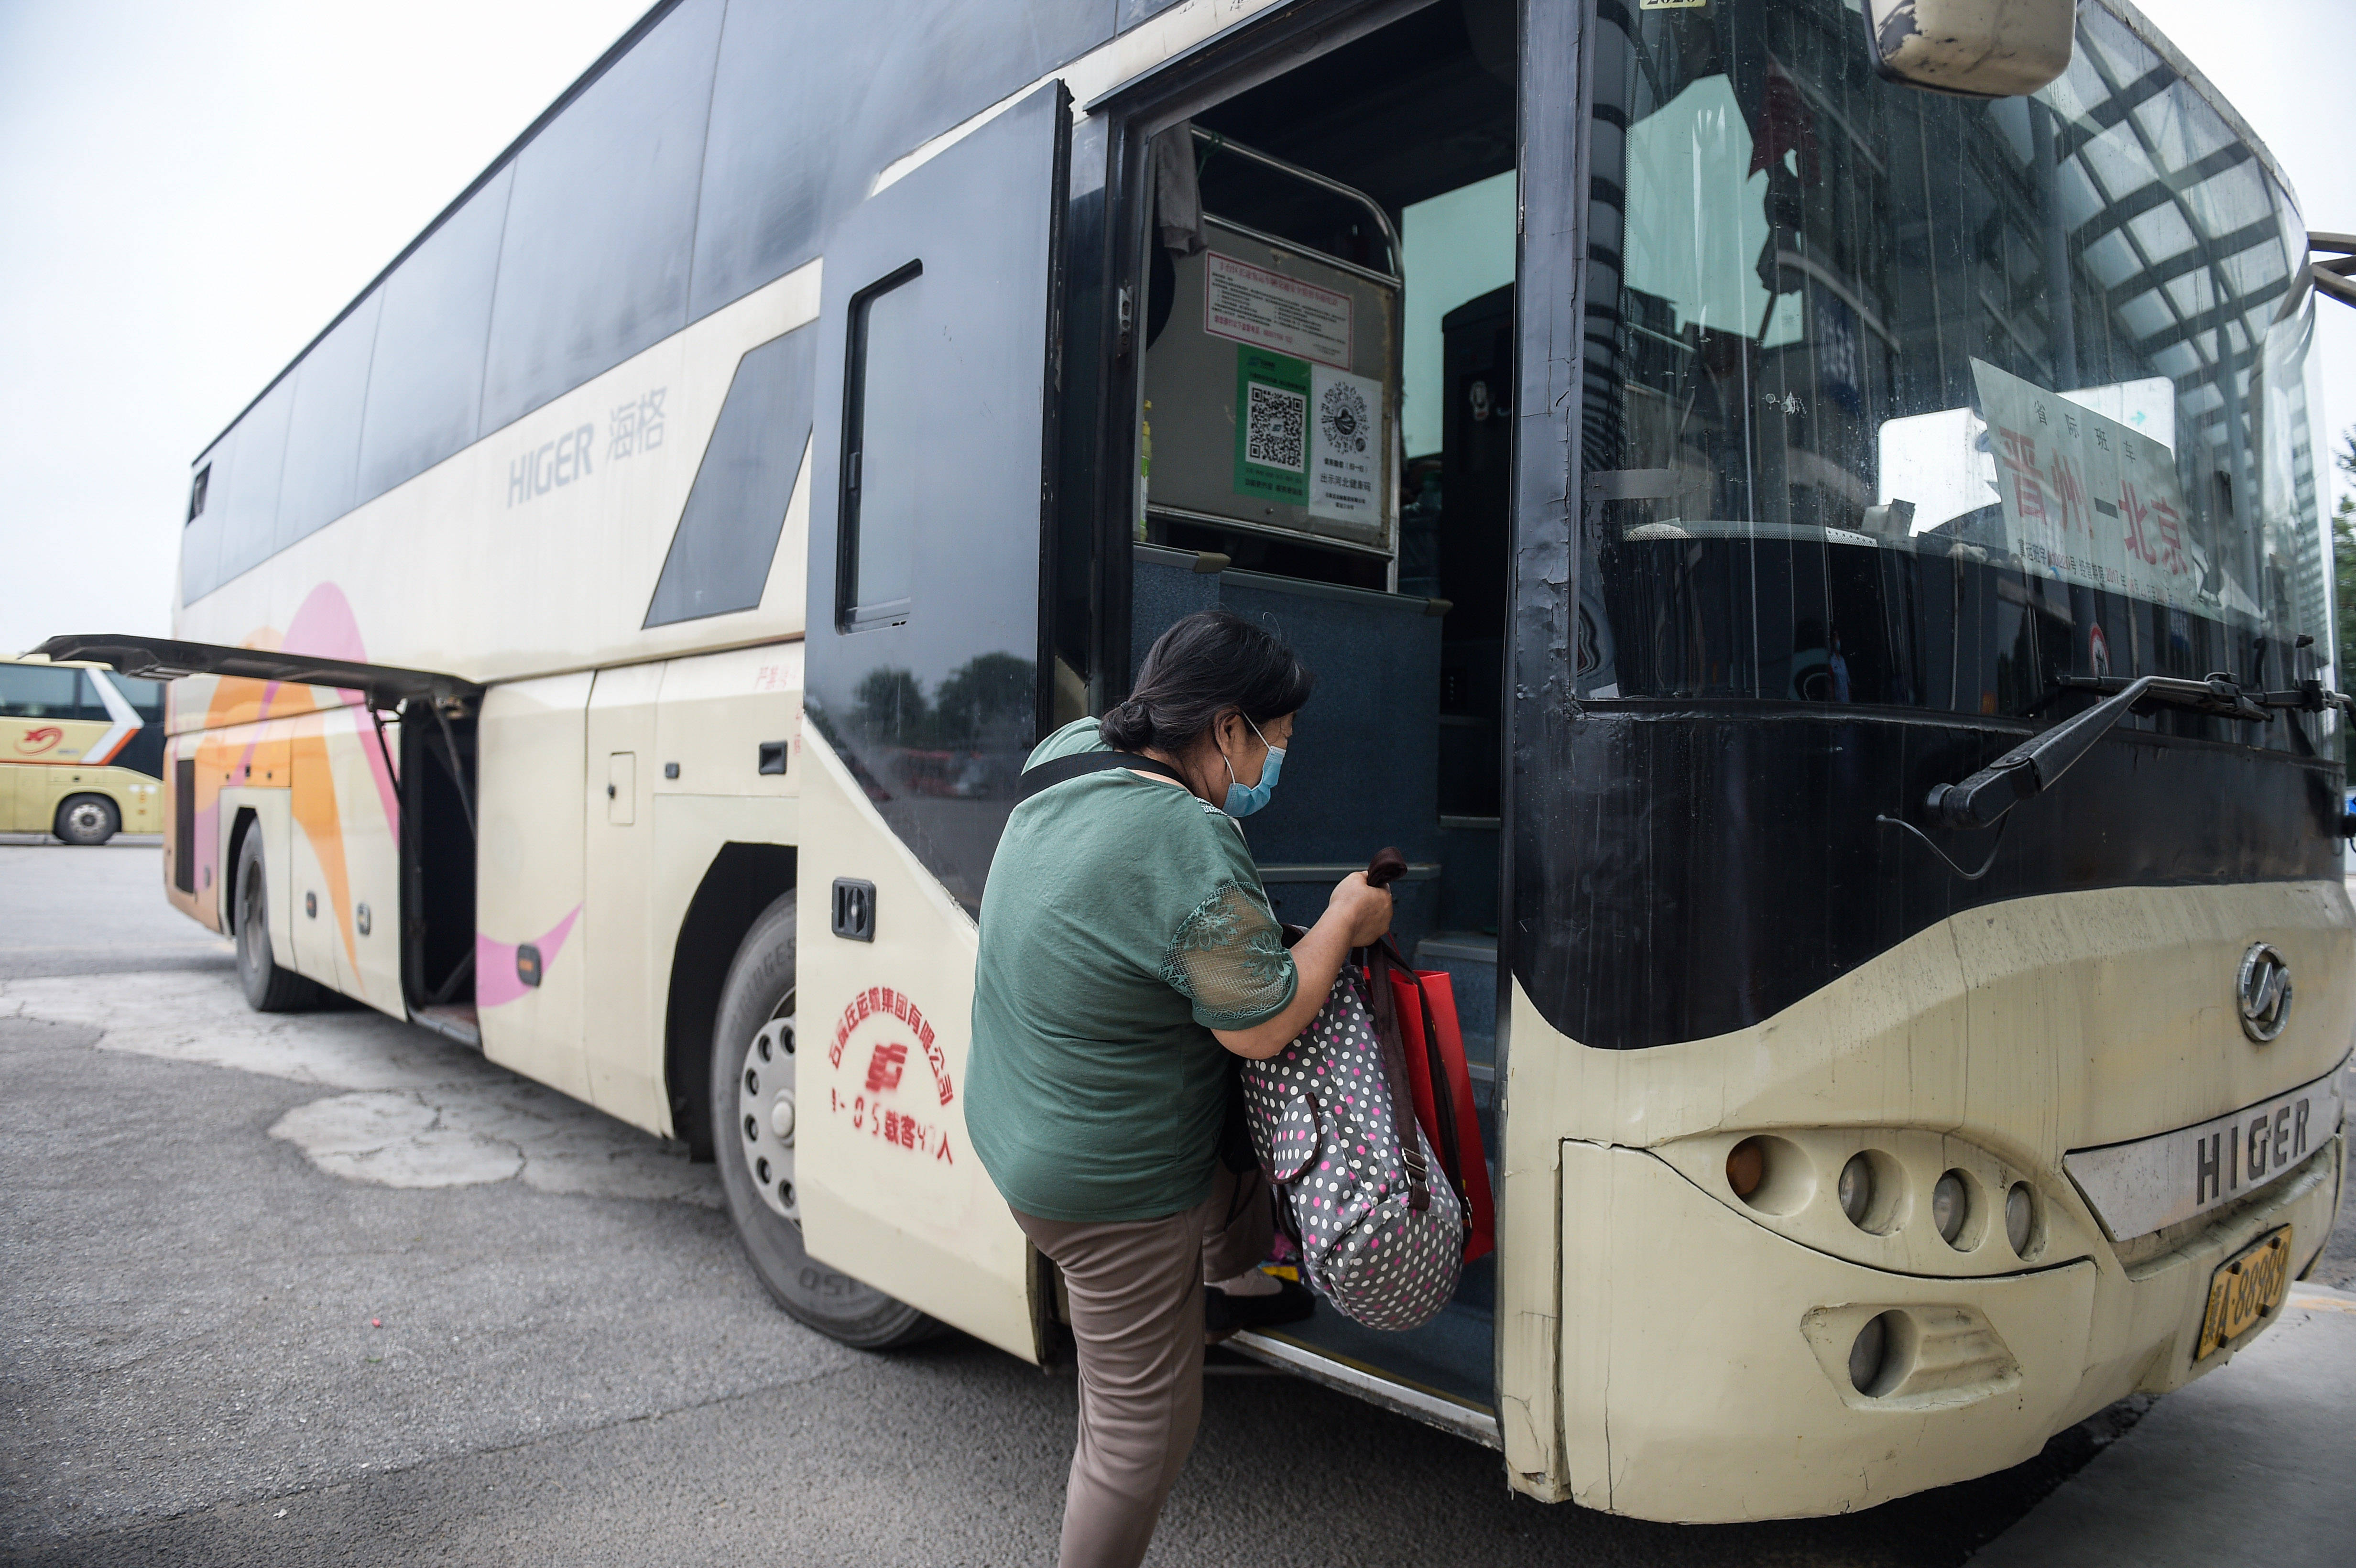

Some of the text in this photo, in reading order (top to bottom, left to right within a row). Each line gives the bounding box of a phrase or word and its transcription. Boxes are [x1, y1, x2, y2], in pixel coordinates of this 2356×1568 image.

[507, 385, 668, 510] HIGER 海格
[2034, 400, 2136, 464] 省际班车
[829, 986, 954, 1107] 石家庄运输集团有限公司
[2197, 1098, 2310, 1206] HIGER
